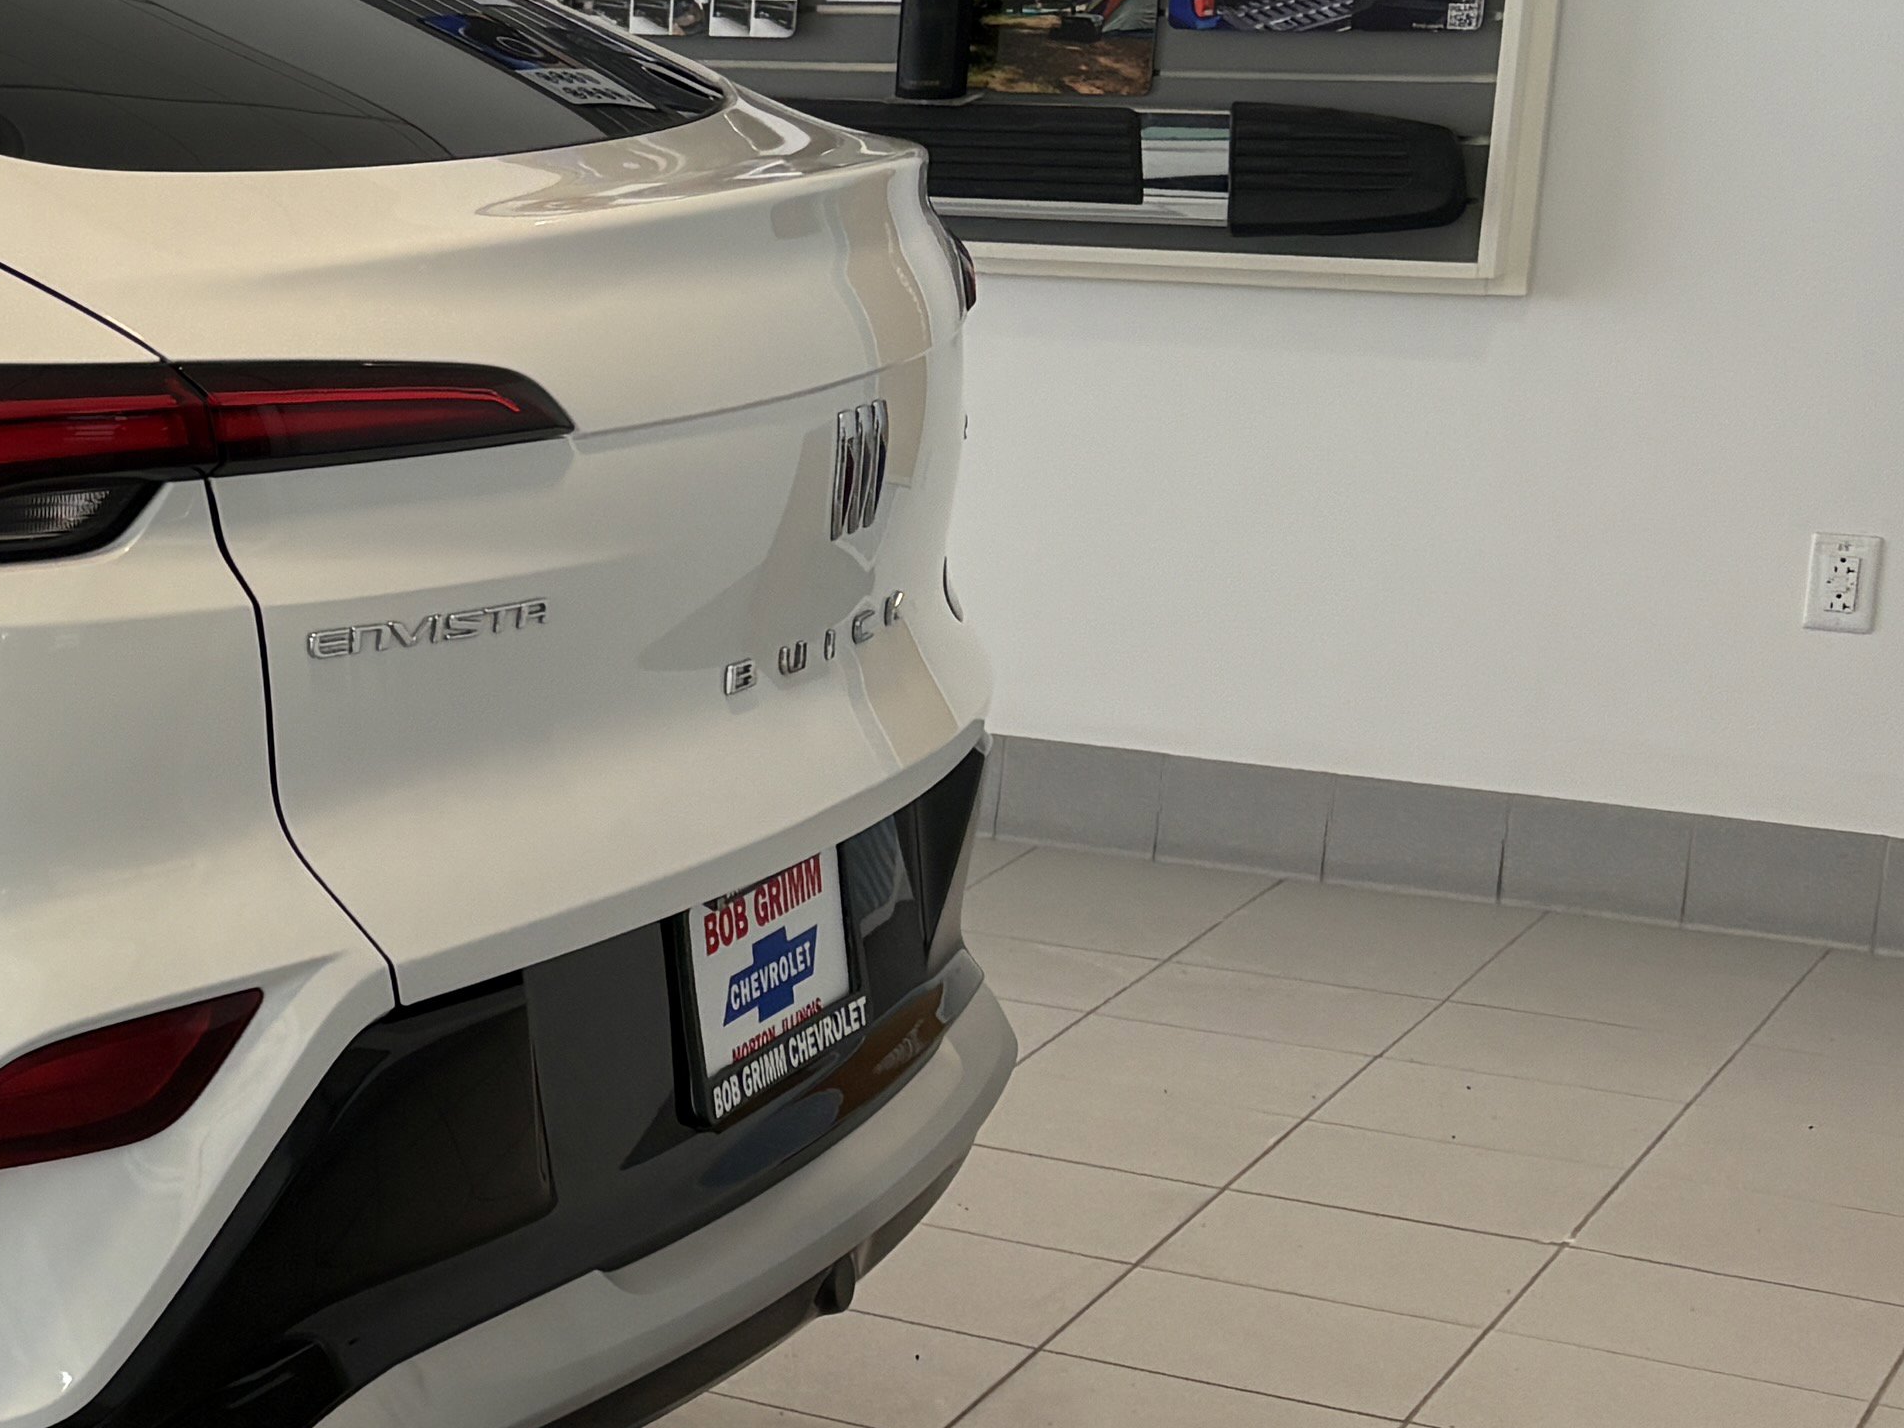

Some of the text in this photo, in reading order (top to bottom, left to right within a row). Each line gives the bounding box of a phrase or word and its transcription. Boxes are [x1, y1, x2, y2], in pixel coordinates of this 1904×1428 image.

[307, 597, 548, 659] ENVISTA
[724, 590, 905, 696] BUICK
[703, 853, 823, 956] BOB GRIMM
[730, 941, 812, 1011] CHEVROLET
[781, 997, 823, 1036] ILLINOIS
[713, 996, 867, 1119] BOB GRIMM CHEVROLET
